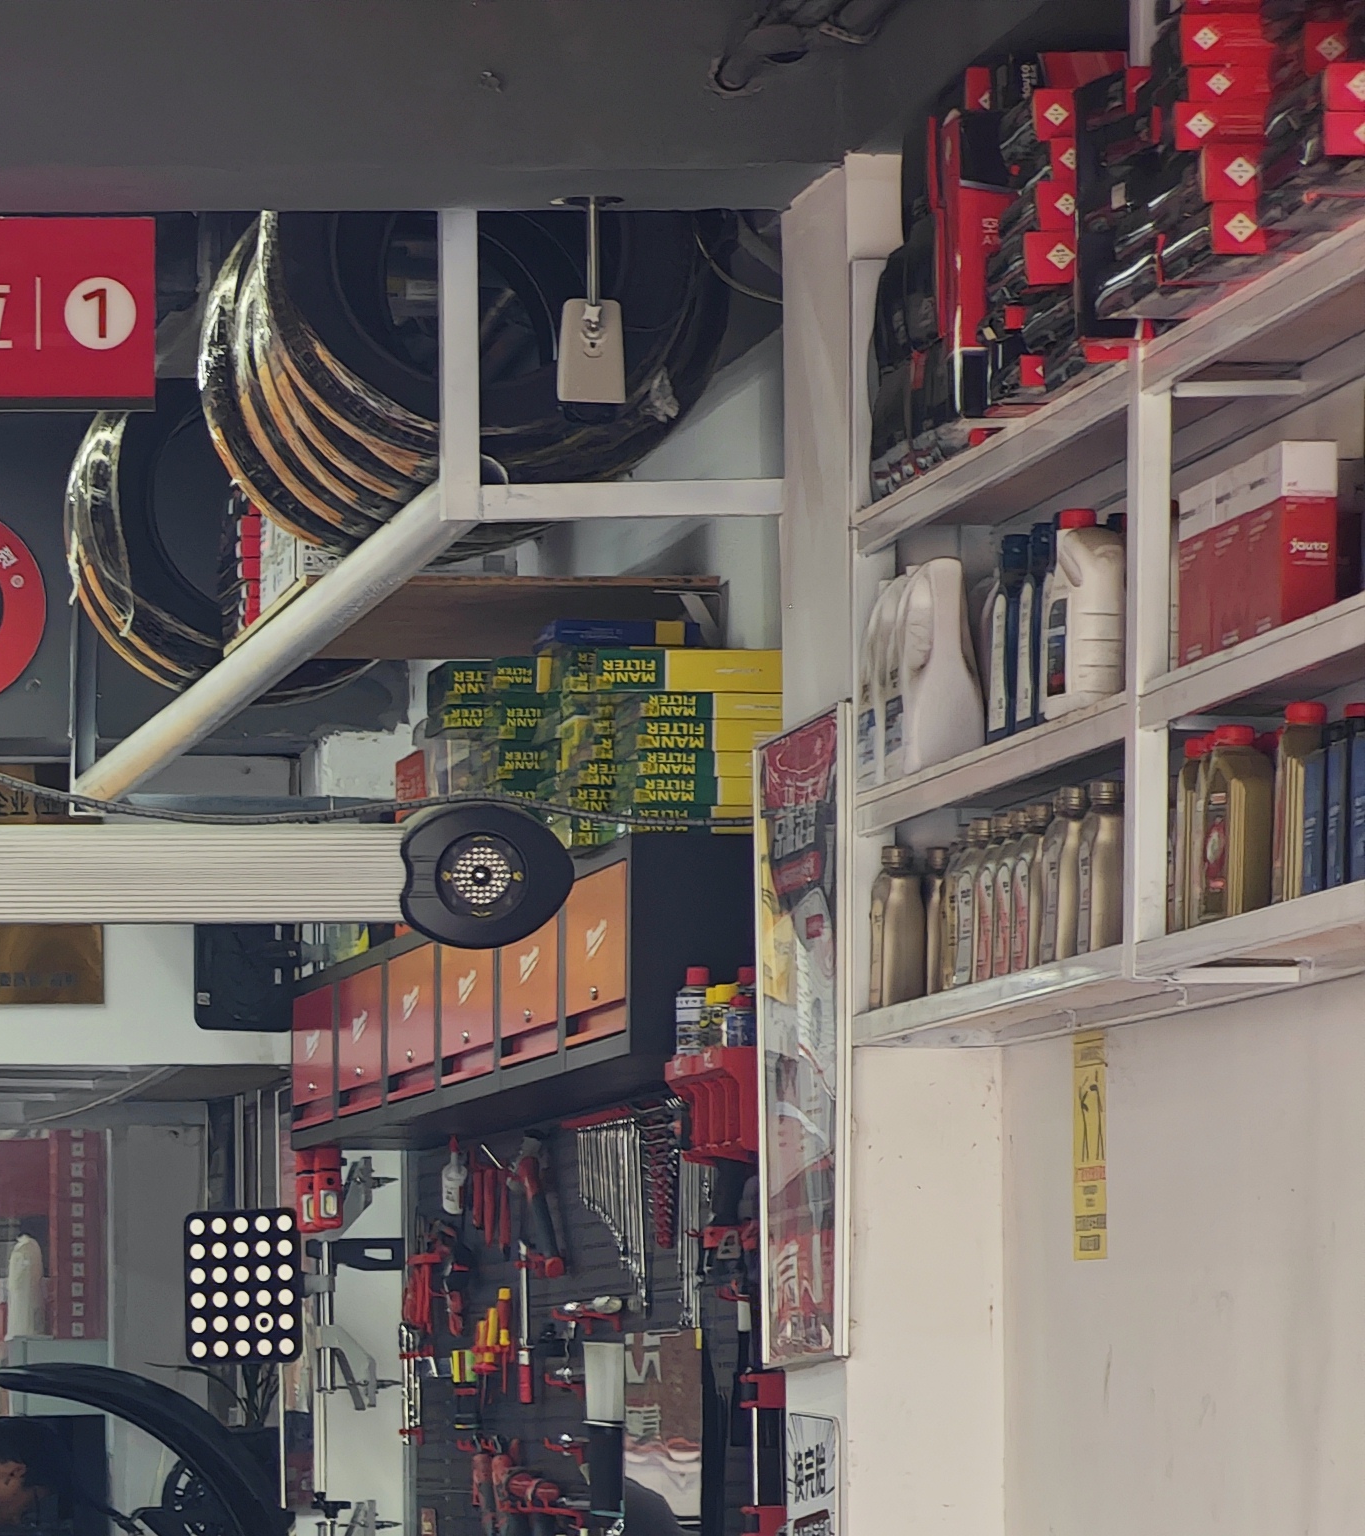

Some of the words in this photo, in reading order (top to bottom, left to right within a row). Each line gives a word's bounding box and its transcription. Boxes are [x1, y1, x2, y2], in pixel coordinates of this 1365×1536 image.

[602, 659, 657, 671] FILTER
[602, 672, 656, 683] MANN
[648, 694, 697, 705] FILTER
[646, 721, 705, 735] FILTER
[647, 752, 696, 763] FILTER
[644, 779, 696, 791] FILTER
